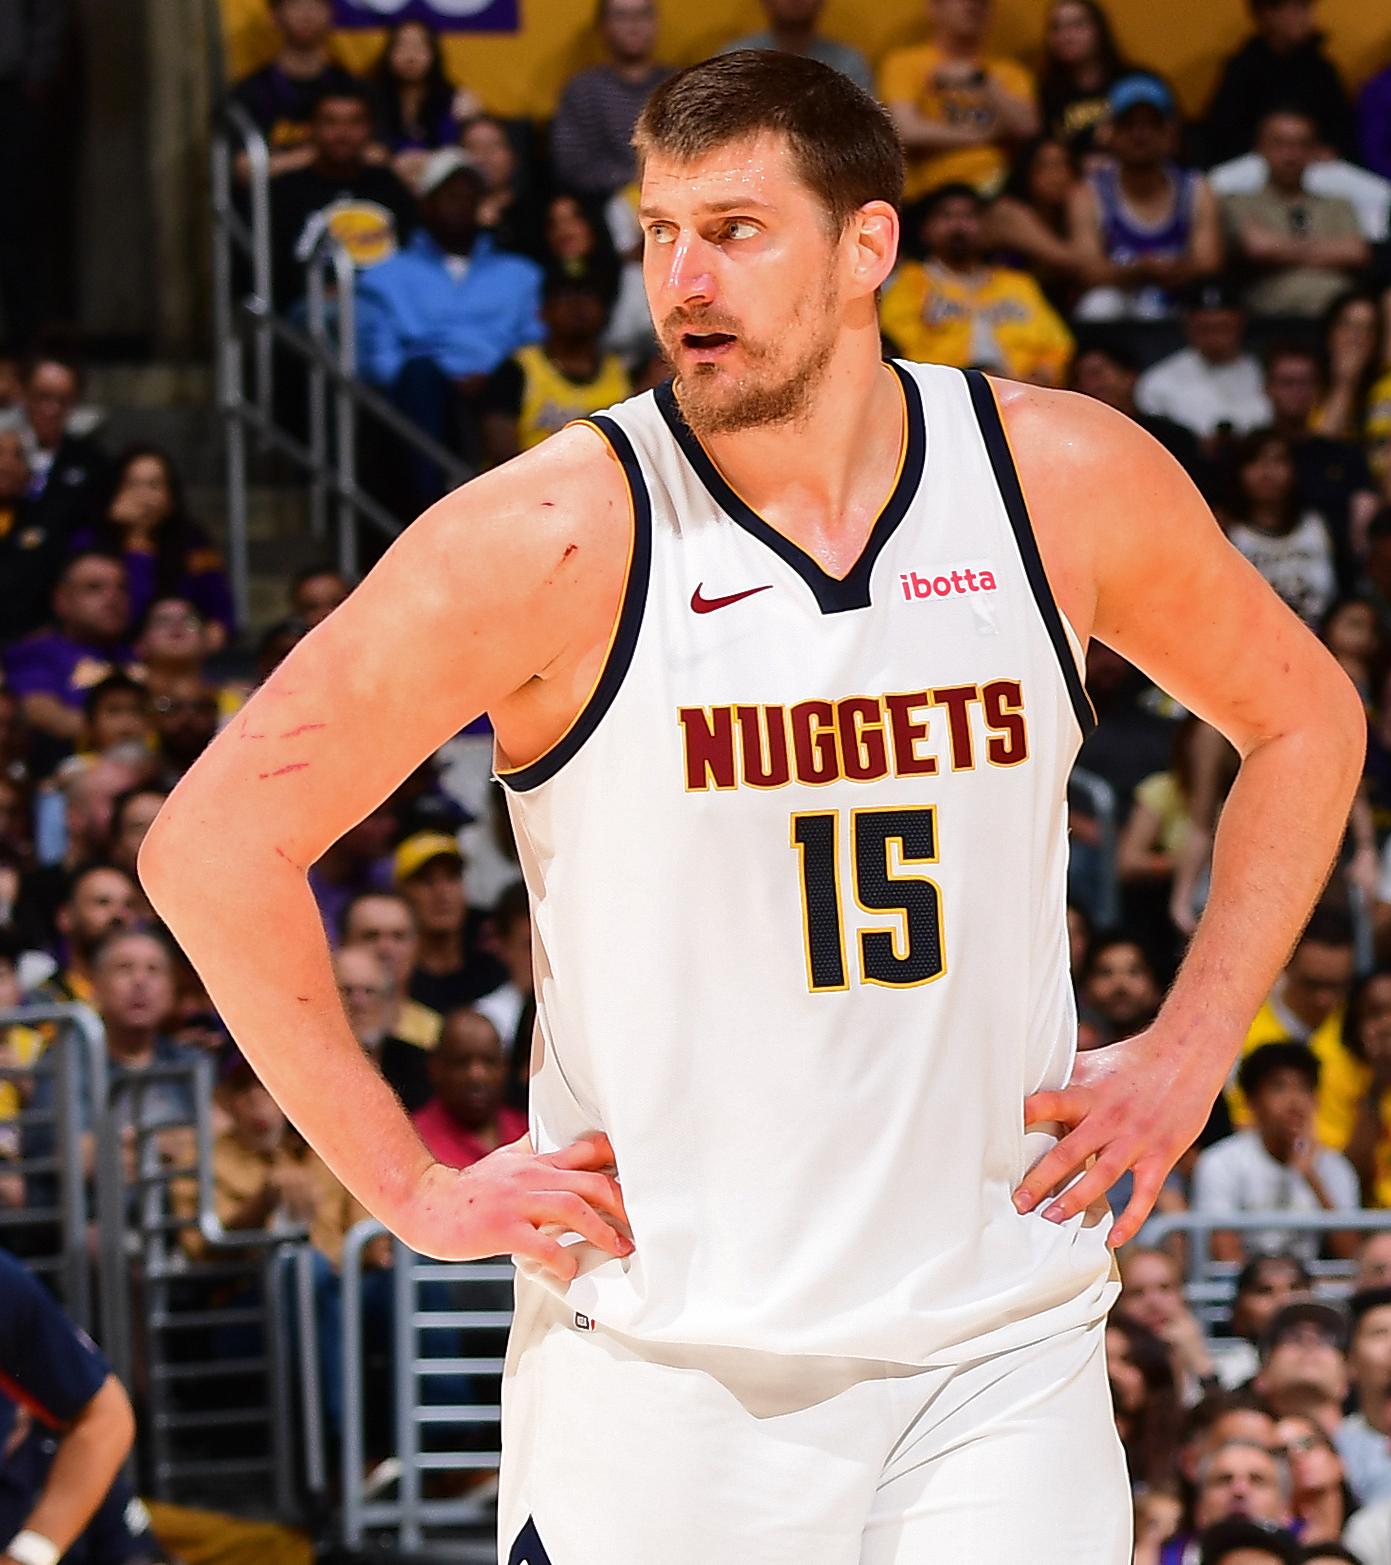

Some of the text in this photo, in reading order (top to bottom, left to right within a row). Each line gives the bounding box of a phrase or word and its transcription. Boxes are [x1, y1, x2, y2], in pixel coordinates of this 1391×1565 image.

[900, 569, 997, 601] ibotta
[677, 679, 1030, 792] NUGGETS
[790, 804, 947, 993] 15
